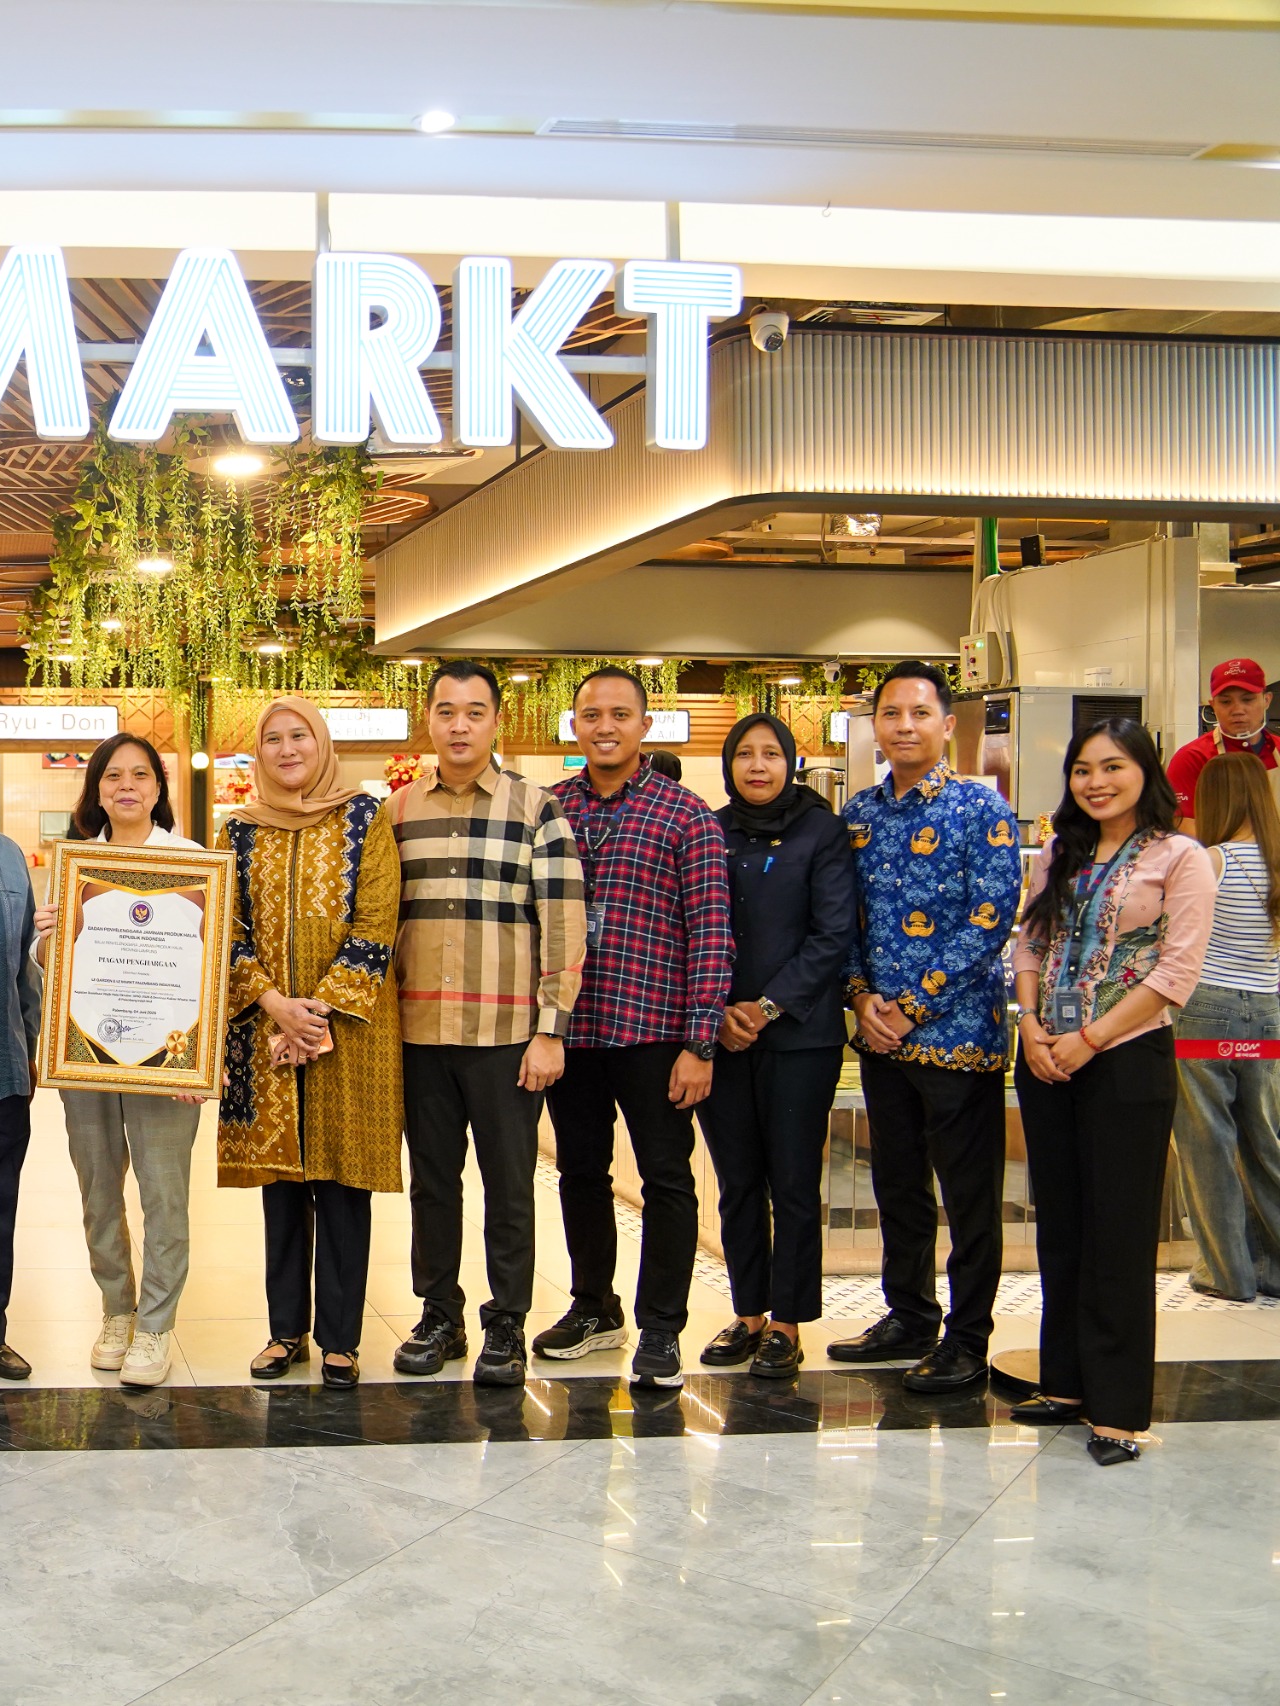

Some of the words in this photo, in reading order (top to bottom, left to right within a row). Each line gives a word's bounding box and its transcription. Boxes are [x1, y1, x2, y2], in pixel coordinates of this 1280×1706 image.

[61, 713, 105, 731] Don
[98, 956, 125, 965] PIAGAM
[126, 958, 177, 968] PENGHARGAAN
